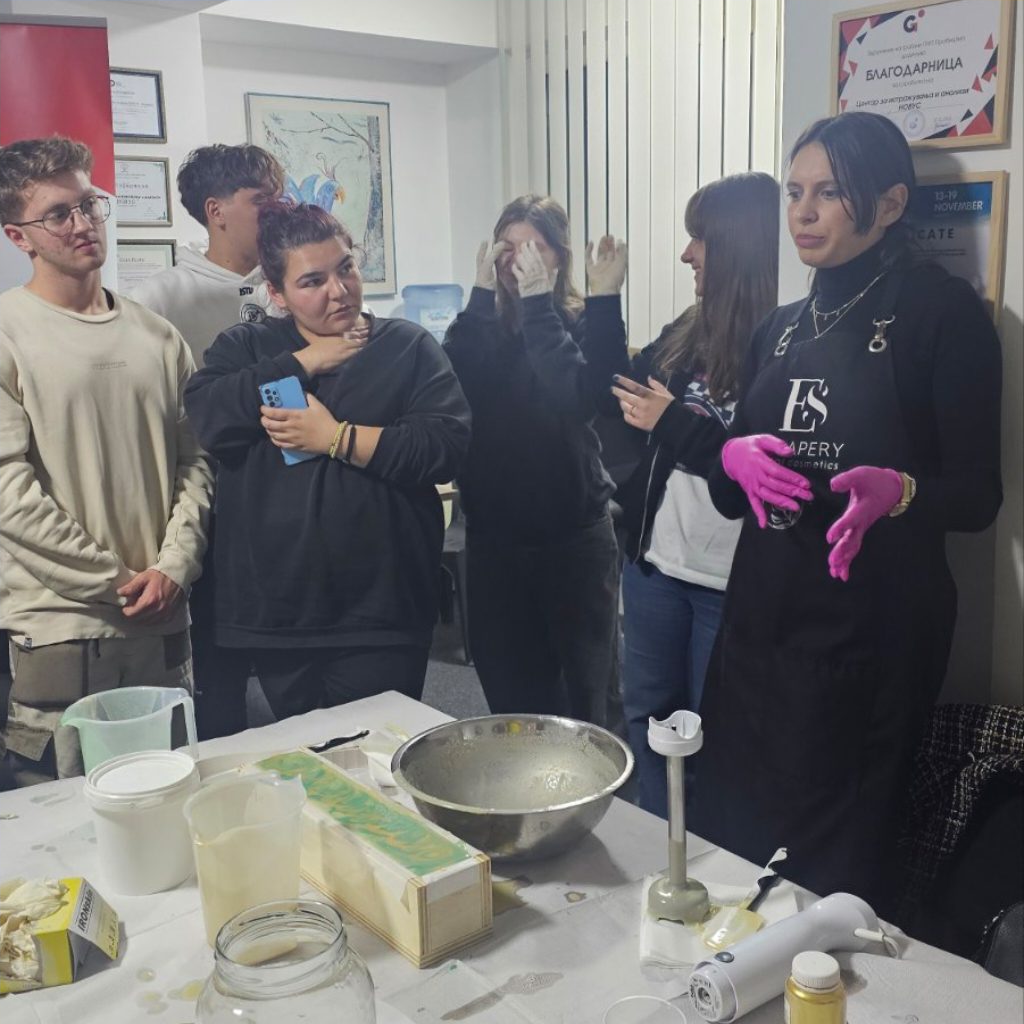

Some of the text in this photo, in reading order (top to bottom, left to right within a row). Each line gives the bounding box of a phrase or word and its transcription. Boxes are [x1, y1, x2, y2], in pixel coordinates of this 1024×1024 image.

[866, 57, 963, 81] БЛАГОДАРНИЦА
[934, 200, 983, 212] NOVEMBER
[789, 441, 844, 458] APERY
